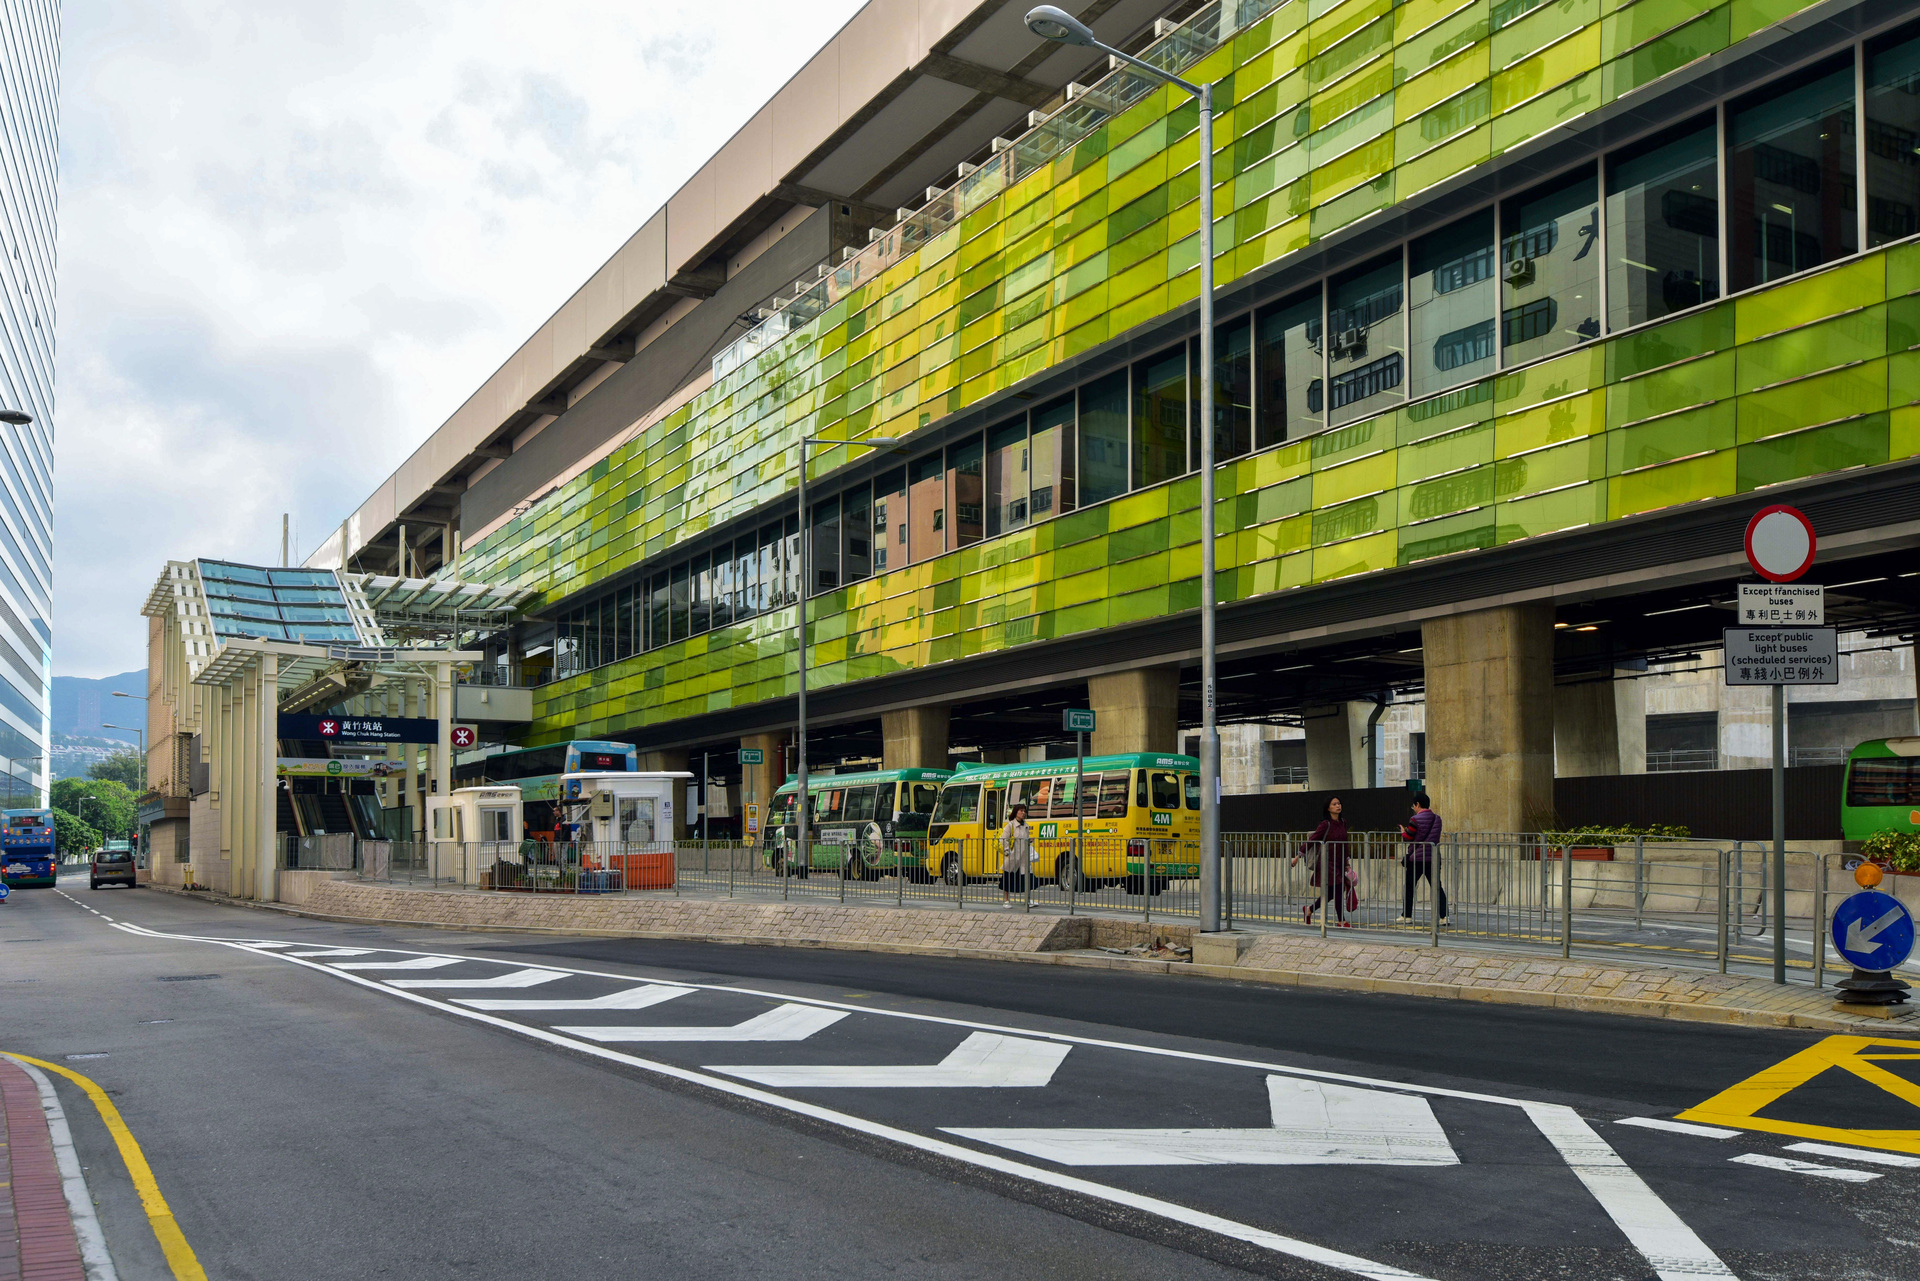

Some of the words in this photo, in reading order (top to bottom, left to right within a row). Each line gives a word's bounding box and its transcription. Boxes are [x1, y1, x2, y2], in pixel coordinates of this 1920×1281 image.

[1743, 587, 1772, 597] Except
[1774, 587, 1820, 596] franchised
[1769, 597, 1794, 605] buses
[1746, 609, 1818, 620] 專利巴士例外
[1748, 633, 1781, 642] Except
[1784, 632, 1814, 642] public
[1755, 644, 1777, 654] light
[1780, 644, 1808, 653] buses
[1731, 655, 1786, 666] (scheduled
[1788, 655, 1832, 665] services)
[342, 720, 382, 731] 黃竹坑站
[1154, 813, 1170, 824] 4M
[1040, 825, 1056, 838] 4M
